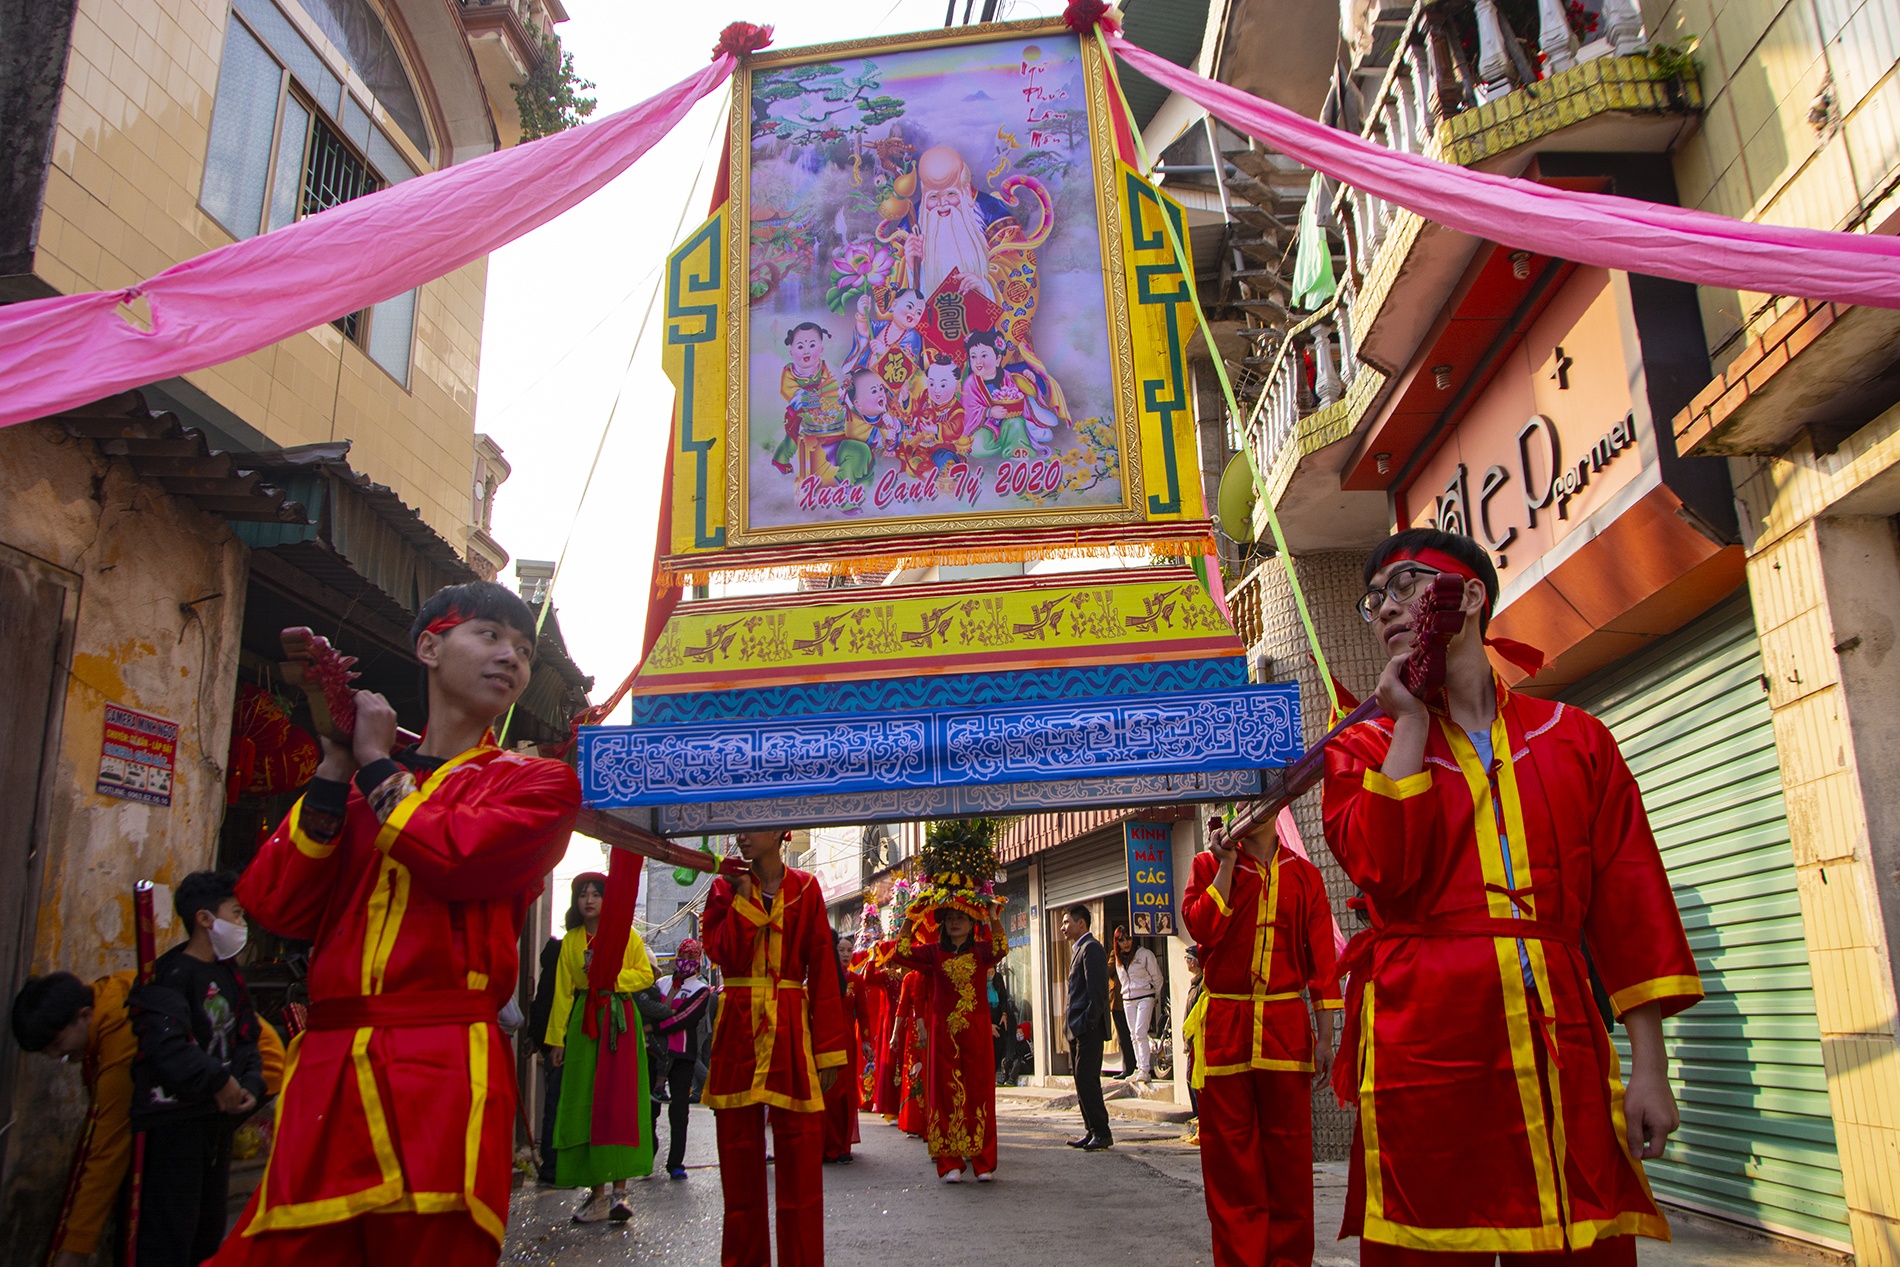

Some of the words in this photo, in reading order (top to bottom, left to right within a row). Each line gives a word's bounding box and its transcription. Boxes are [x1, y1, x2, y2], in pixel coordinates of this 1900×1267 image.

[1022, 86, 1067, 102] Phúc
[799, 474, 865, 509] Xuân
[873, 466, 938, 509] Canh
[950, 463, 983, 506] Tý
[995, 460, 1062, 496] 2020
[105, 707, 135, 729] CAMERA
[1131, 824, 1167, 840] KÍNH
[1134, 844, 1165, 862] MẮT
[1136, 867, 1167, 884] CÁC
[1135, 893, 1169, 909] LOẠI
